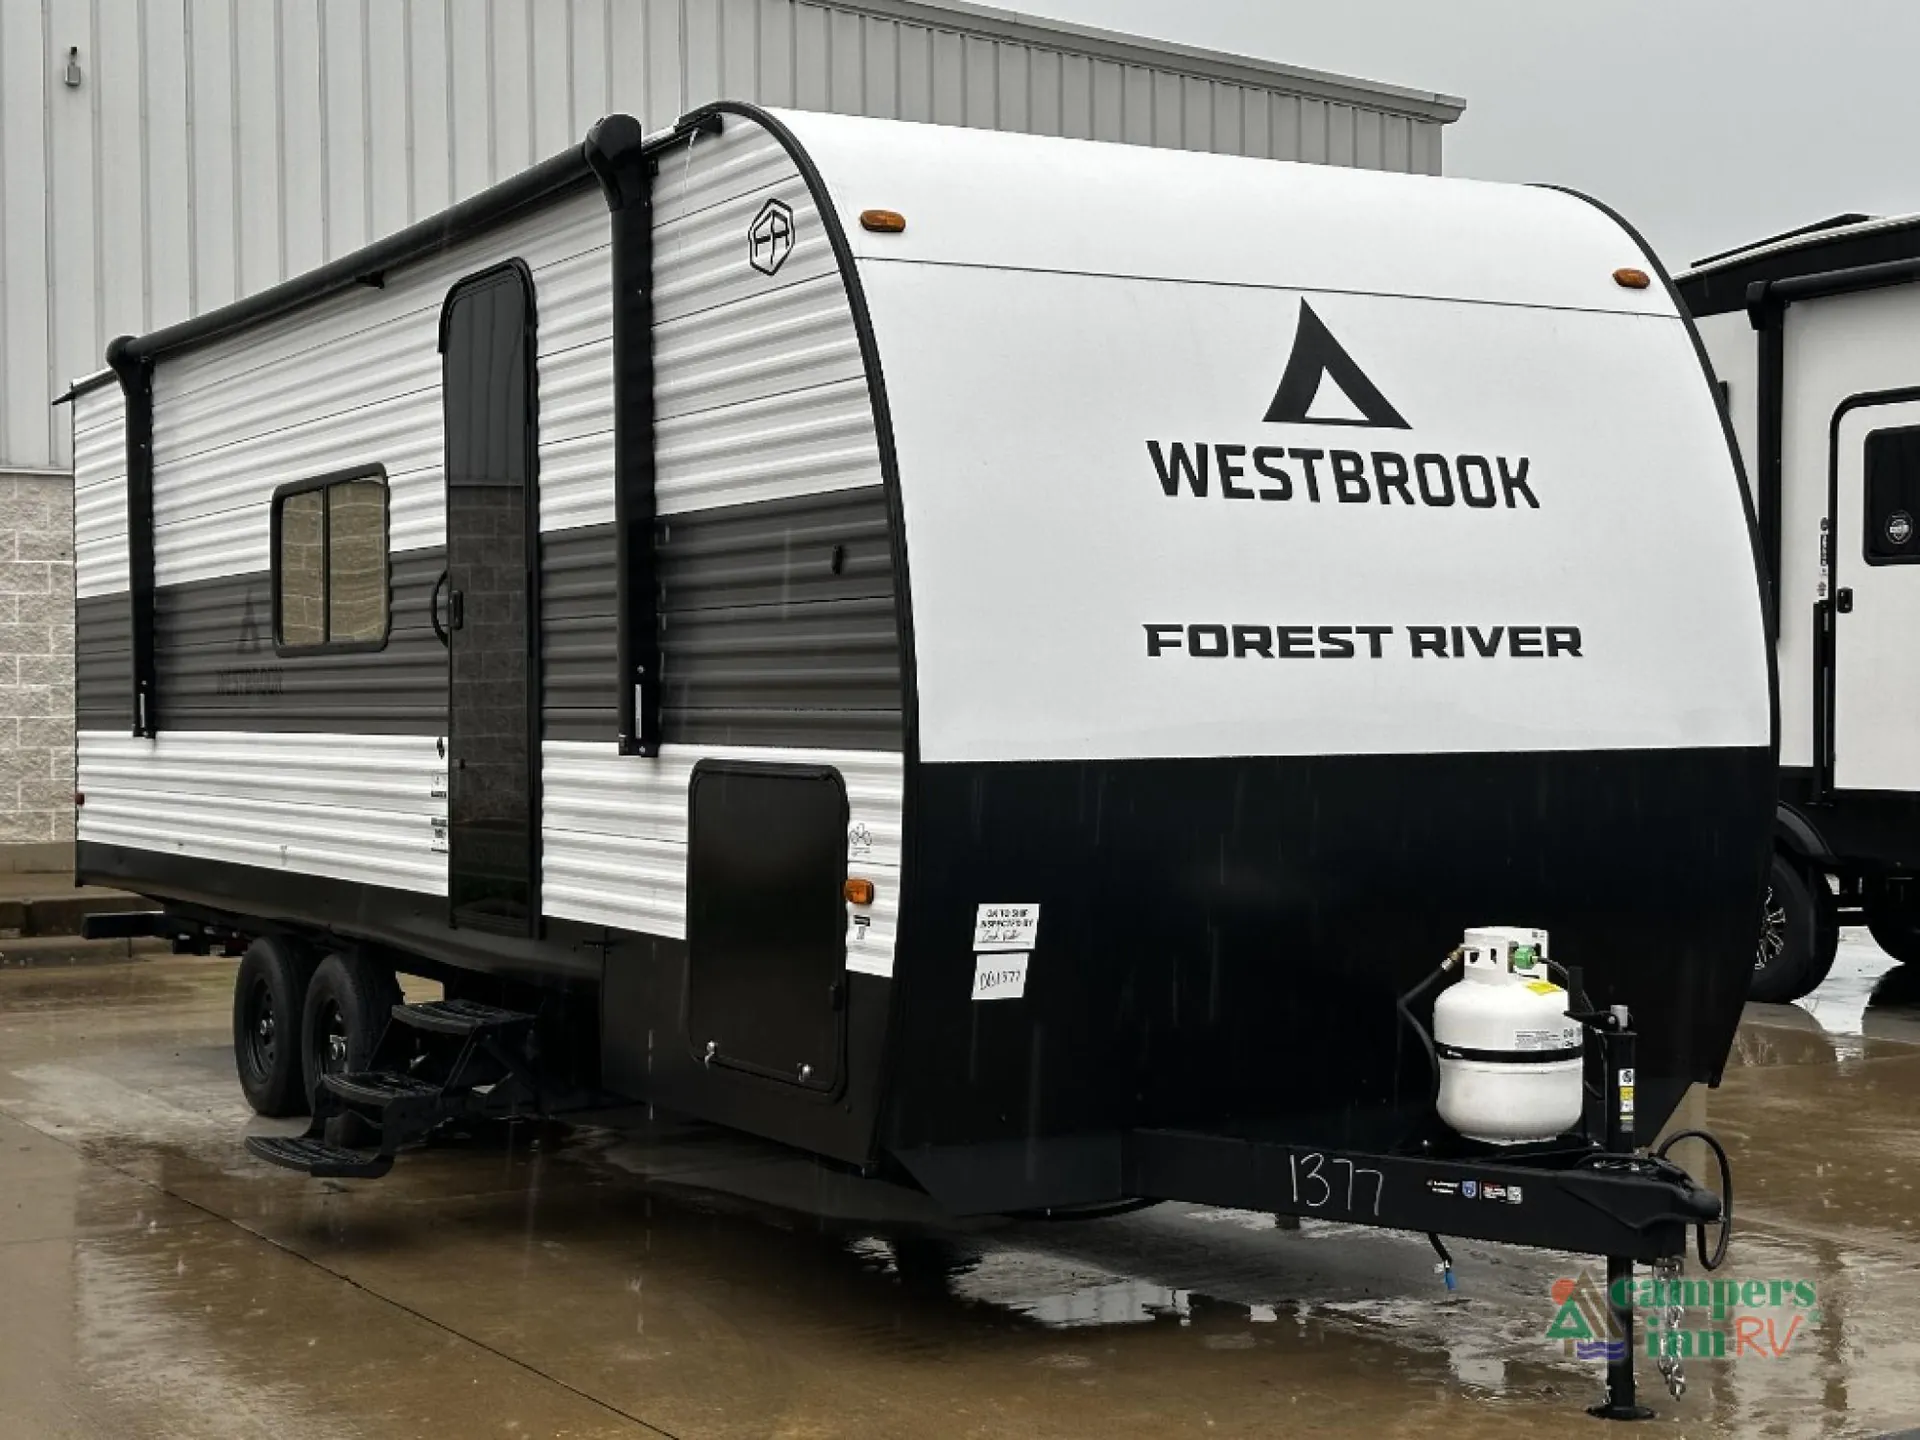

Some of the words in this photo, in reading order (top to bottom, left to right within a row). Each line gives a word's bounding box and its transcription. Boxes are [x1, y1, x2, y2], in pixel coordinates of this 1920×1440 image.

[1145, 439, 1541, 509] WESTBROOK
[1142, 623, 1394, 660] FOREST
[1405, 624, 1584, 660] RIVER
[1289, 1152, 1385, 1217] 1377
